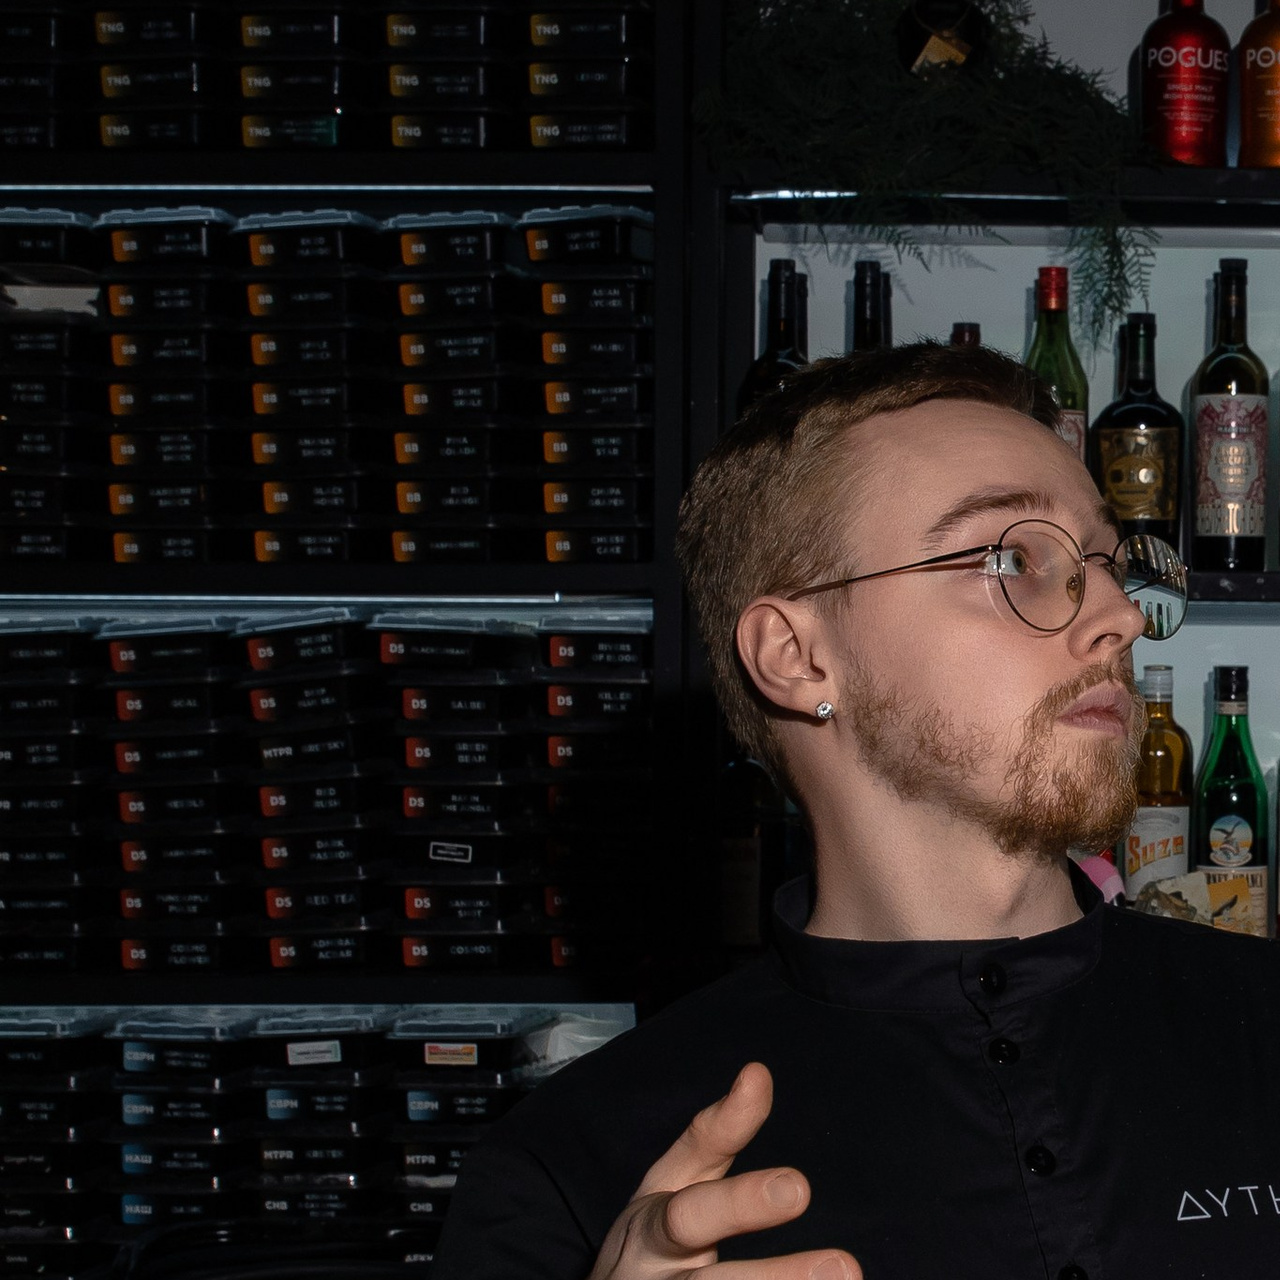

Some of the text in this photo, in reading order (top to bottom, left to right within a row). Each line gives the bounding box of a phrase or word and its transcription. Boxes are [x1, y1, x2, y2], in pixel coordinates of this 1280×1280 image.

[101, 23, 124, 32] TNG
[247, 26, 270, 36] TNG
[392, 25, 416, 35] TNG
[536, 25, 559, 35] TNG
[1148, 46, 1229, 72] POGUES
[107, 76, 130, 85] TNG
[247, 77, 271, 86] TNG
[395, 75, 418, 85] TNG
[534, 74, 558, 84] TNG
[106, 126, 129, 135] TNG
[249, 127, 270, 136] TNG
[397, 126, 421, 136] TNG
[536, 126, 559, 136] TNG
[258, 647, 274, 658] DS
[389, 643, 404, 653] DS
[559, 646, 574, 656] DS
[120, 650, 135, 660] DS
[126, 700, 142, 710] DS
[260, 698, 276, 708] DS
[412, 699, 426, 709] DS
[557, 696, 572, 706] DS
[415, 747, 430, 757] DS
[557, 746, 572, 756] DS
[125, 752, 140, 762] DS
[270, 796, 286, 806] DS
[409, 797, 424, 807] DS
[129, 802, 144, 812] DS
[131, 851, 147, 861] DS
[272, 847, 288, 857] DS
[1126, 835, 1185, 876] Suze
[126, 898, 141, 908] DS
[275, 897, 292, 907] DS
[414, 898, 430, 908] DS
[131, 949, 146, 959] DS
[280, 947, 295, 956] DS
[412, 946, 427, 956] DS
